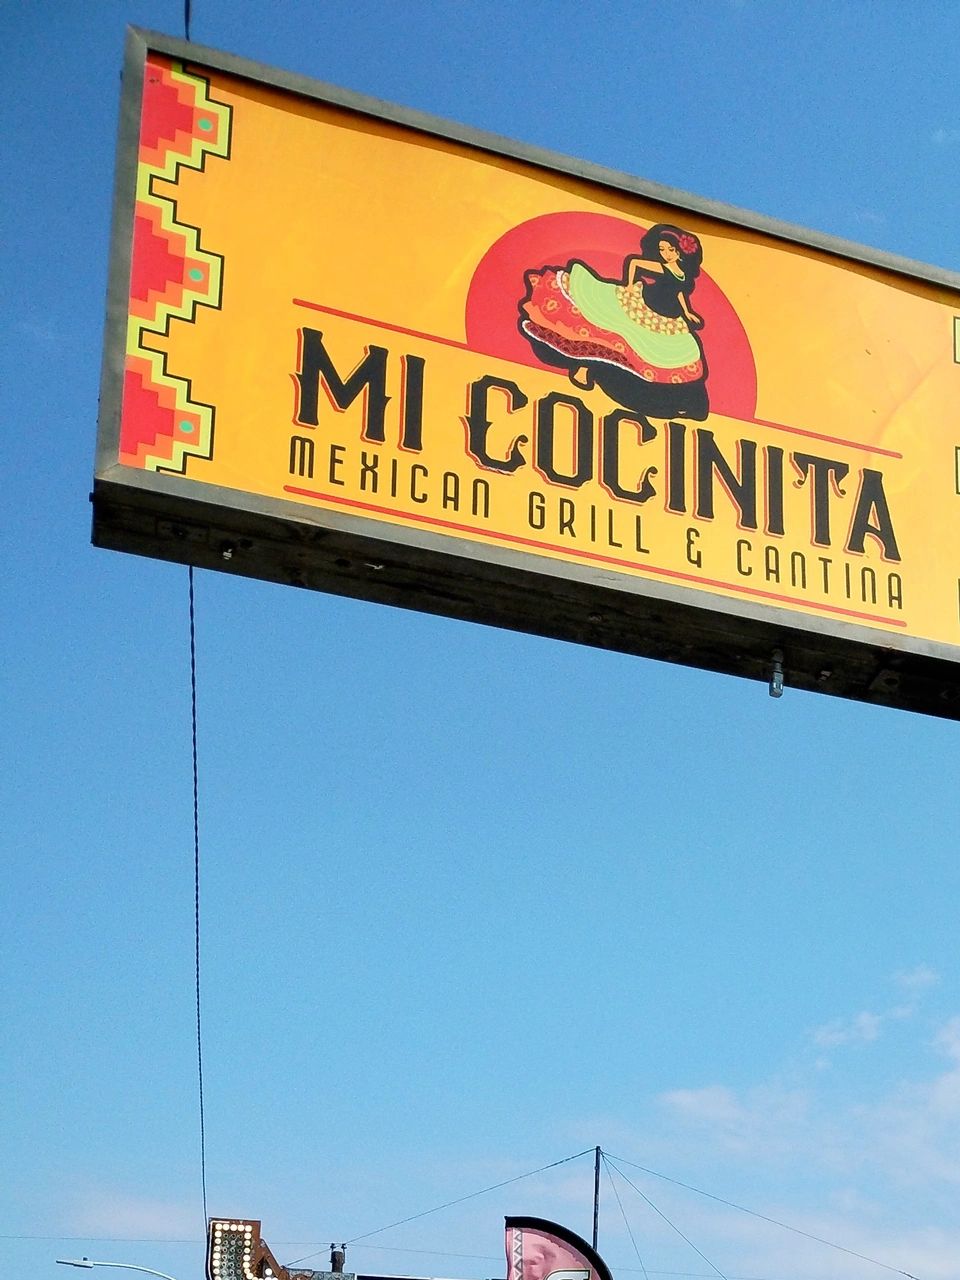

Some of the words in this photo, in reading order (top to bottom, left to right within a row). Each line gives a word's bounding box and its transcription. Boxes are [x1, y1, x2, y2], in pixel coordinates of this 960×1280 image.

[288, 435, 492, 520] MEXICAN
[528, 489, 651, 556] GRILL
[685, 528, 706, 567] &
[734, 541, 906, 612] CANTINA
[290, 327, 427, 453] MI
[460, 374, 902, 564] COCINITA
